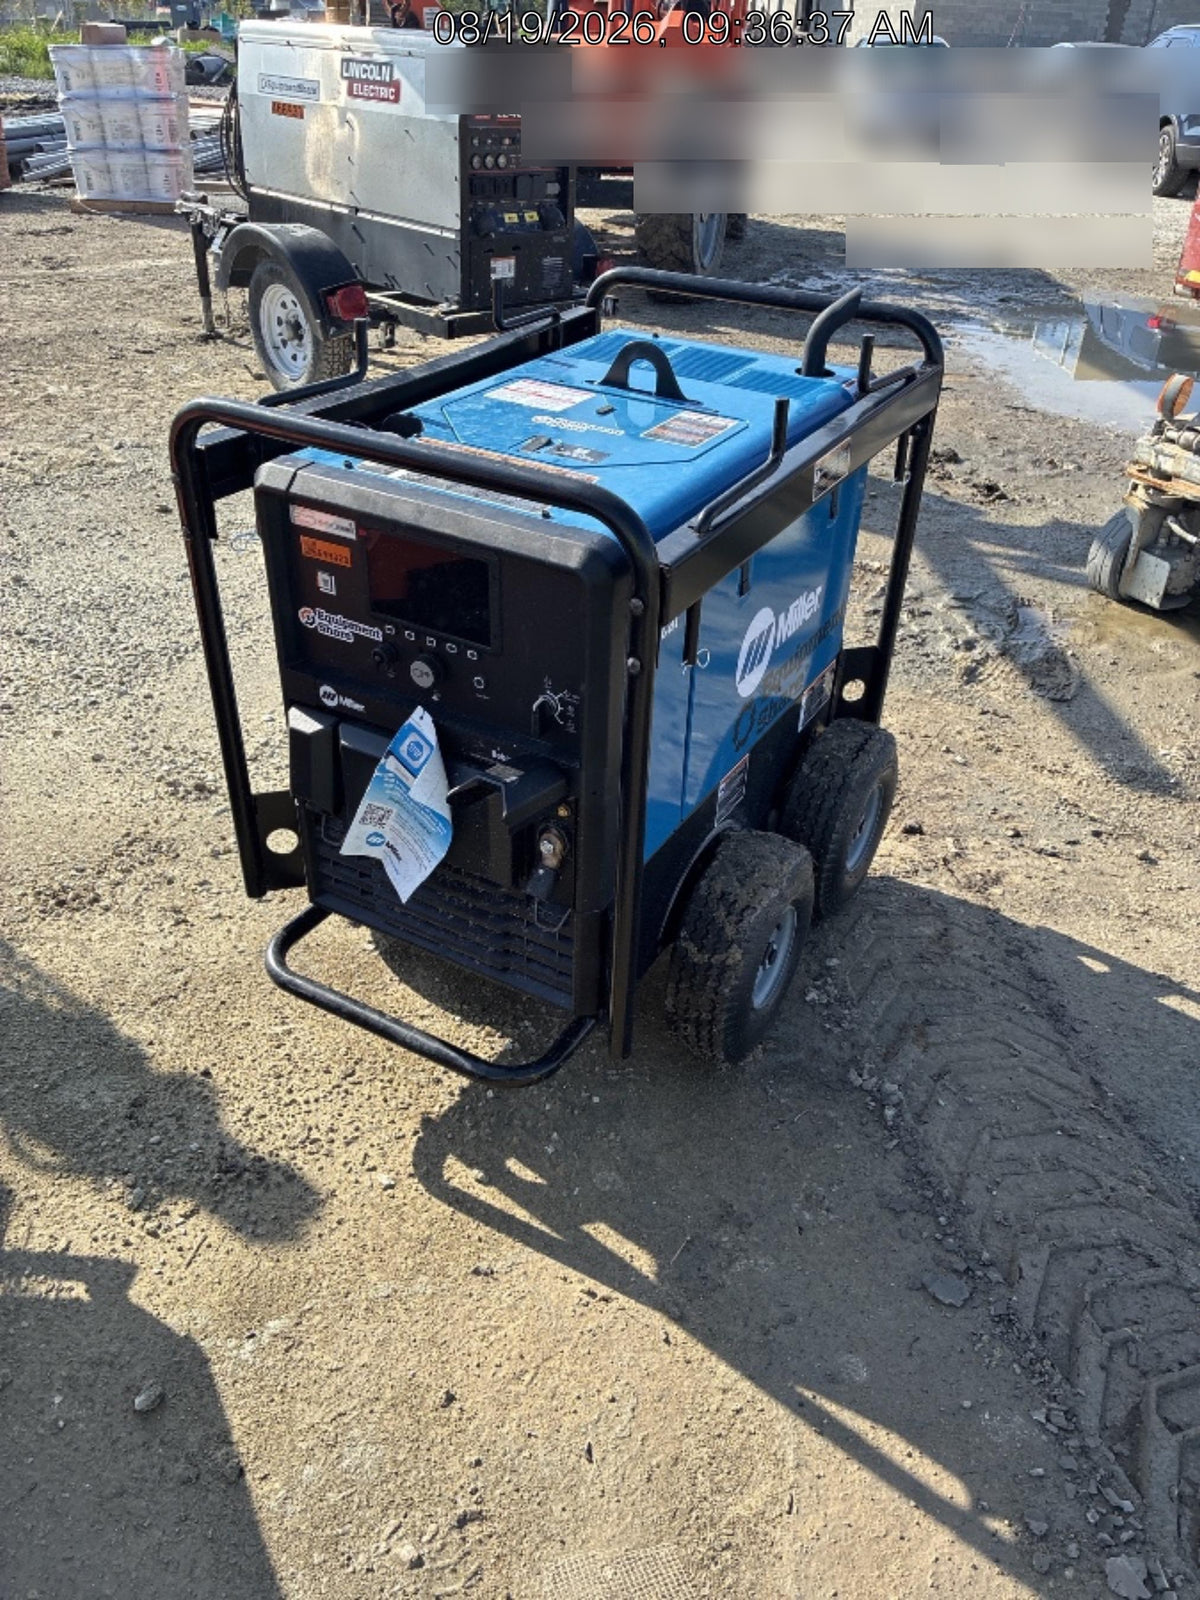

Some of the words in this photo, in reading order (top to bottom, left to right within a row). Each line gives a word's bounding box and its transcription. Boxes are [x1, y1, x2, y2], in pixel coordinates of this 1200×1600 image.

[342, 60, 391, 82] LINCOLN
[353, 83, 396, 100] ELECTRIC
[314, 608, 383, 642] Equipment
[774, 585, 823, 651] Miller
[339, 694, 366, 712] Miller
